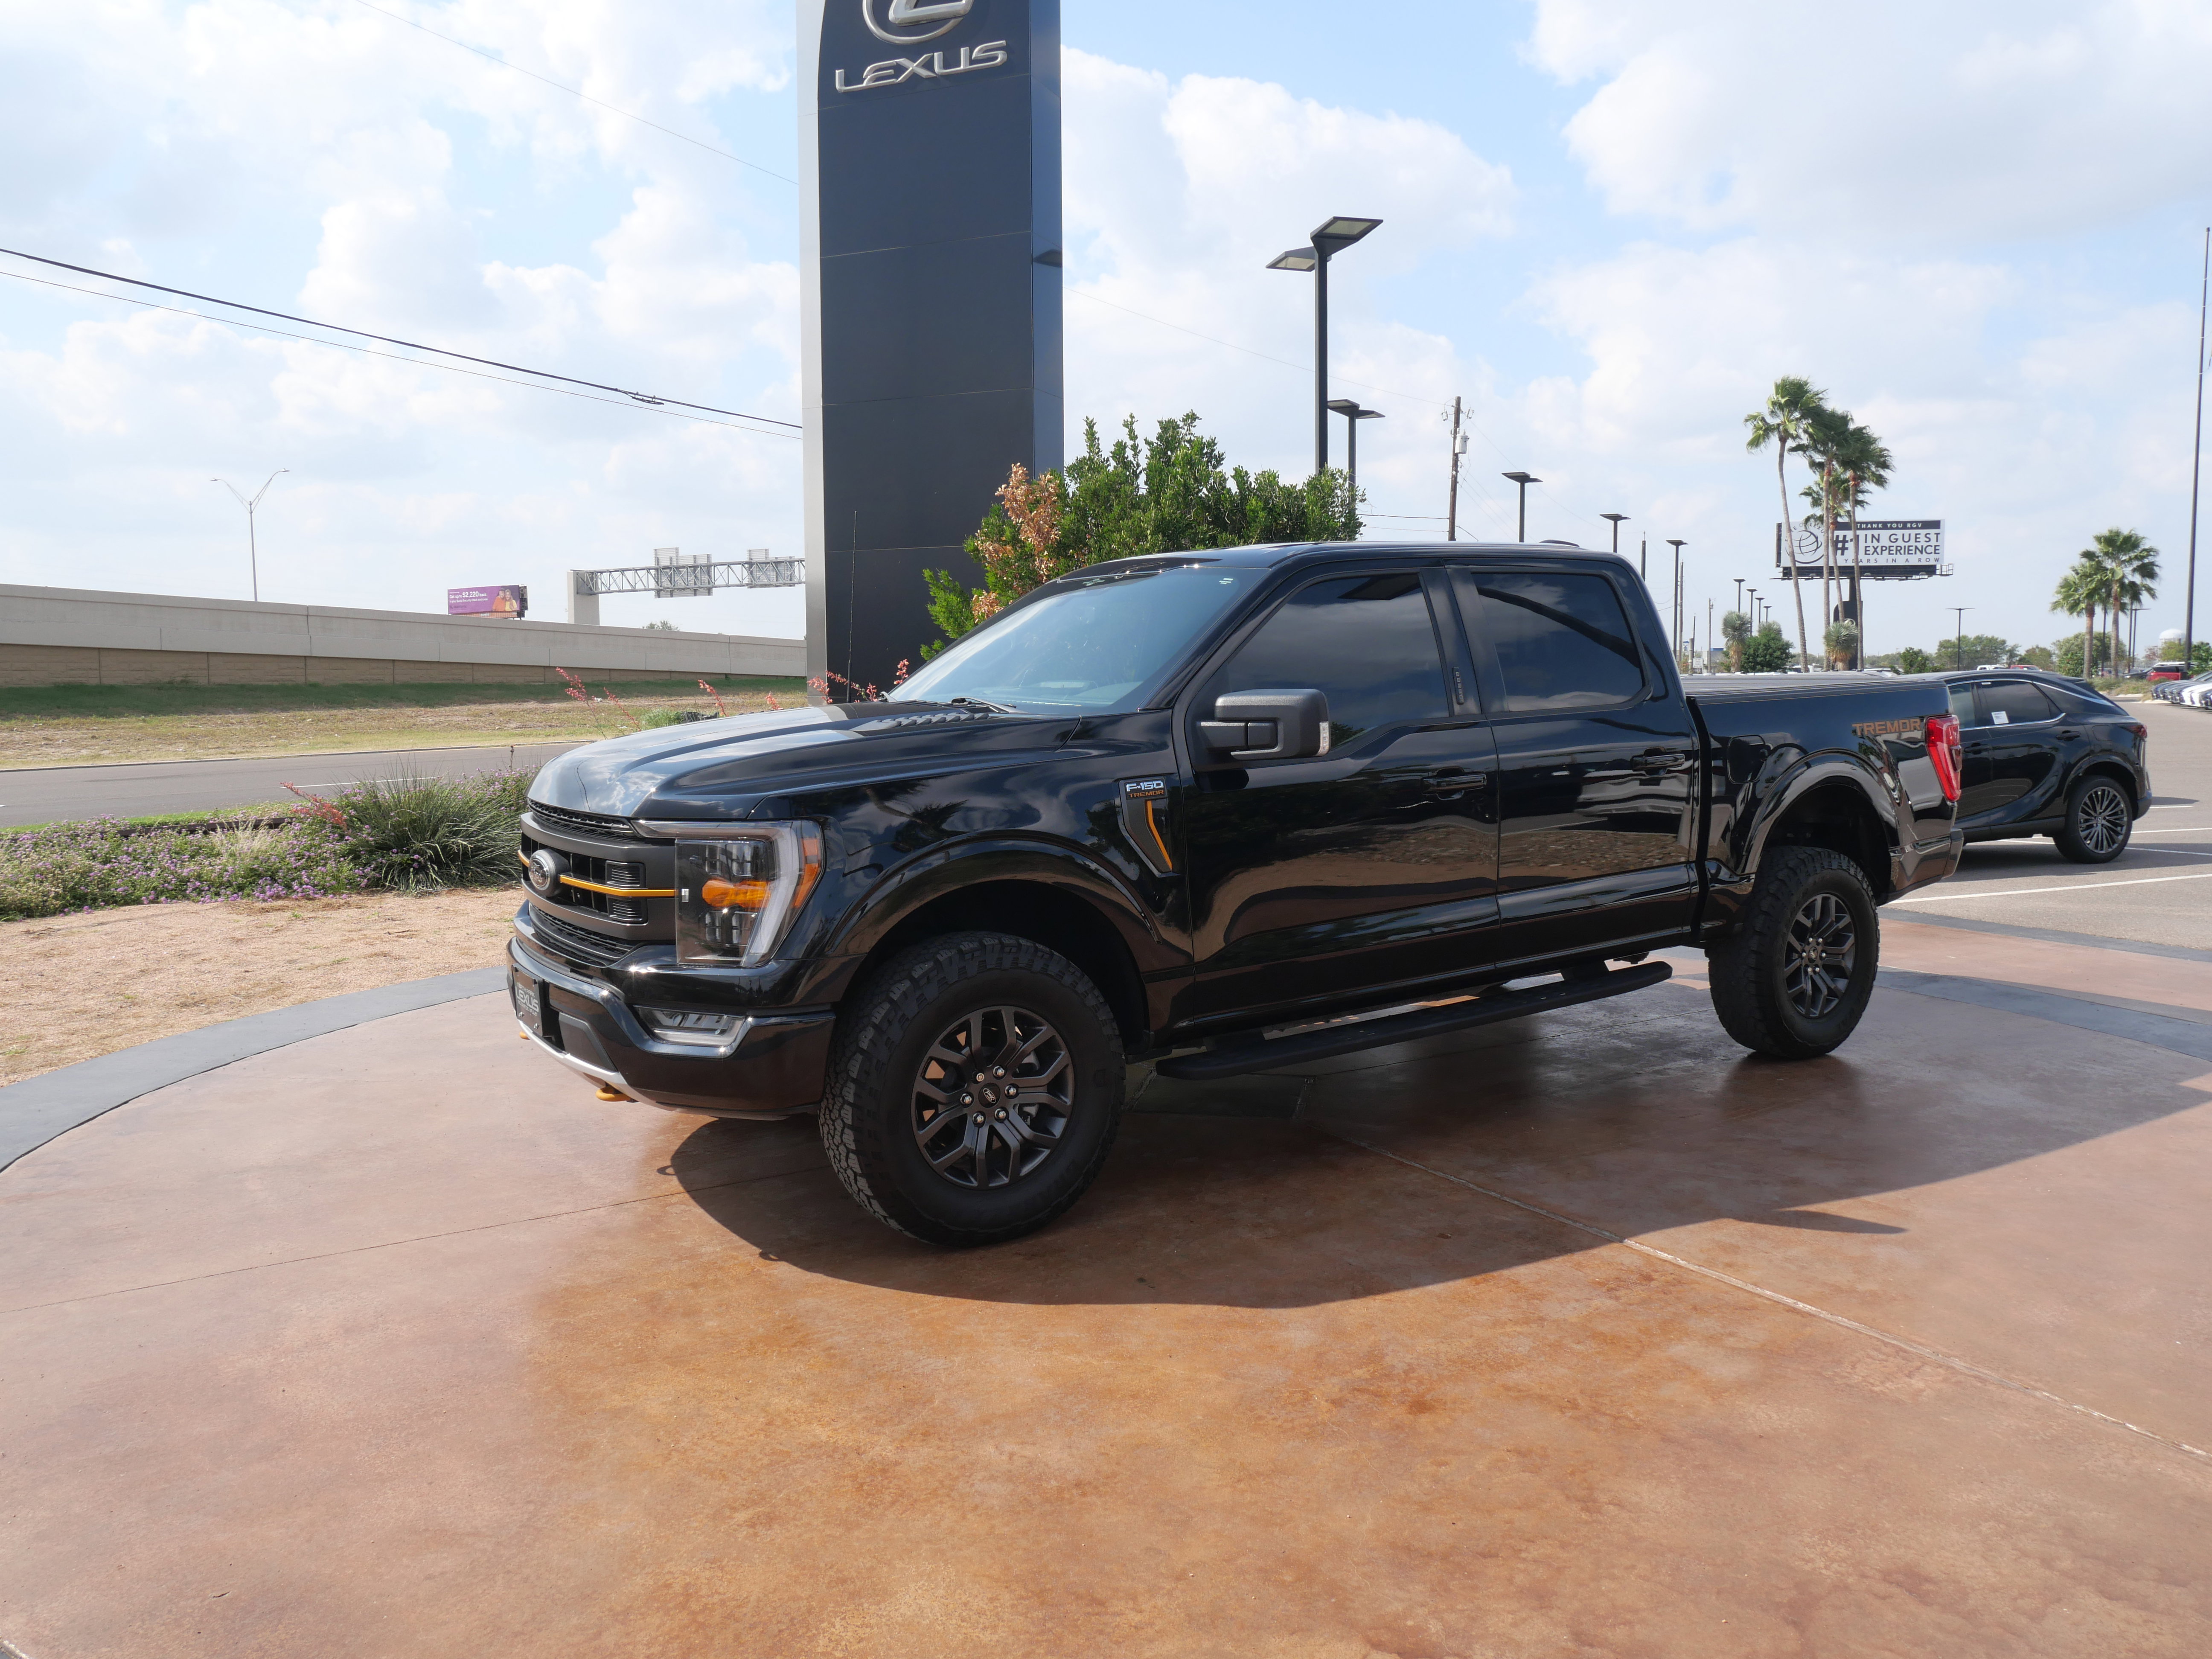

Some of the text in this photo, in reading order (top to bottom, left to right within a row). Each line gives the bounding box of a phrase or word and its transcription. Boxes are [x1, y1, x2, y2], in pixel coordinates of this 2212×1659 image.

[835, 40, 1007, 93] LEXUS
[1865, 533, 1941, 543] IN GUEST
[1864, 545, 1941, 555] EXPERIENCE
[1851, 718, 1921, 736] TREMOR
[1126, 780, 1164, 792] F-150
[1129, 790, 1164, 798] TREMOR
[515, 986, 539, 1012] LEXUS
[985, 1090, 995, 1101] Ford
